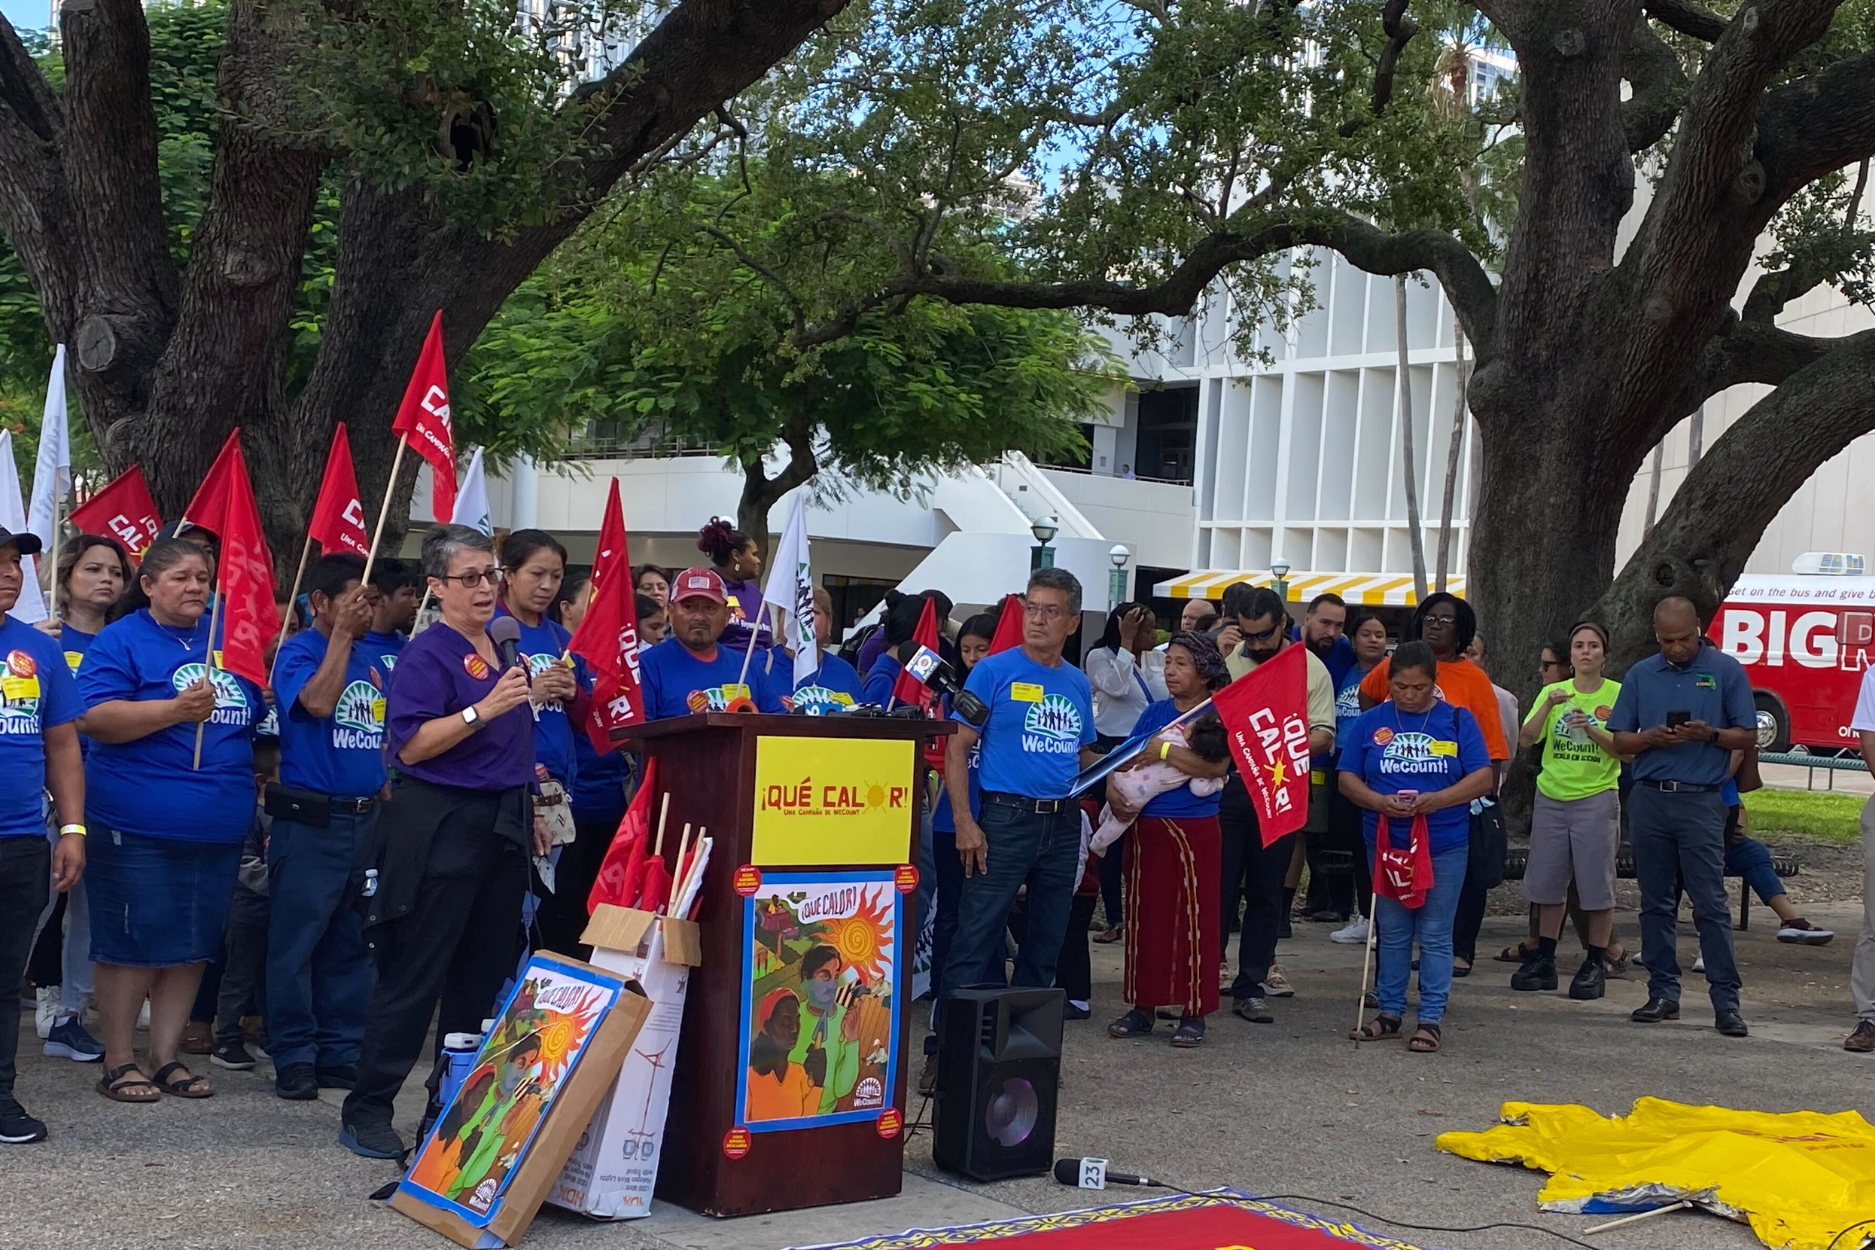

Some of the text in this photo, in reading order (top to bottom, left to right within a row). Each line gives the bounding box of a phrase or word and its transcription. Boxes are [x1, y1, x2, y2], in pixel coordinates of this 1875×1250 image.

[1750, 588, 1764, 597] on
[1768, 587, 1786, 597] the
[1790, 588, 1810, 598] bus
[1814, 588, 1836, 598] and
[1840, 588, 1865, 600] give
[1721, 609, 1839, 669] BIG
[332, 728, 383, 750] WeCou
[1235, 730, 1247, 748] UNA
[1242, 747, 1260, 778] CAMPAÑA
[1379, 757, 1449, 774] WeCount!
[761, 776, 812, 811] ¡QUÉ
[798, 807, 823, 816] CAMPAÑA
[822, 886, 857, 916] CALOR!
[1085, 1166, 1100, 1187] 23
[556, 1185, 586, 1209] HDX
